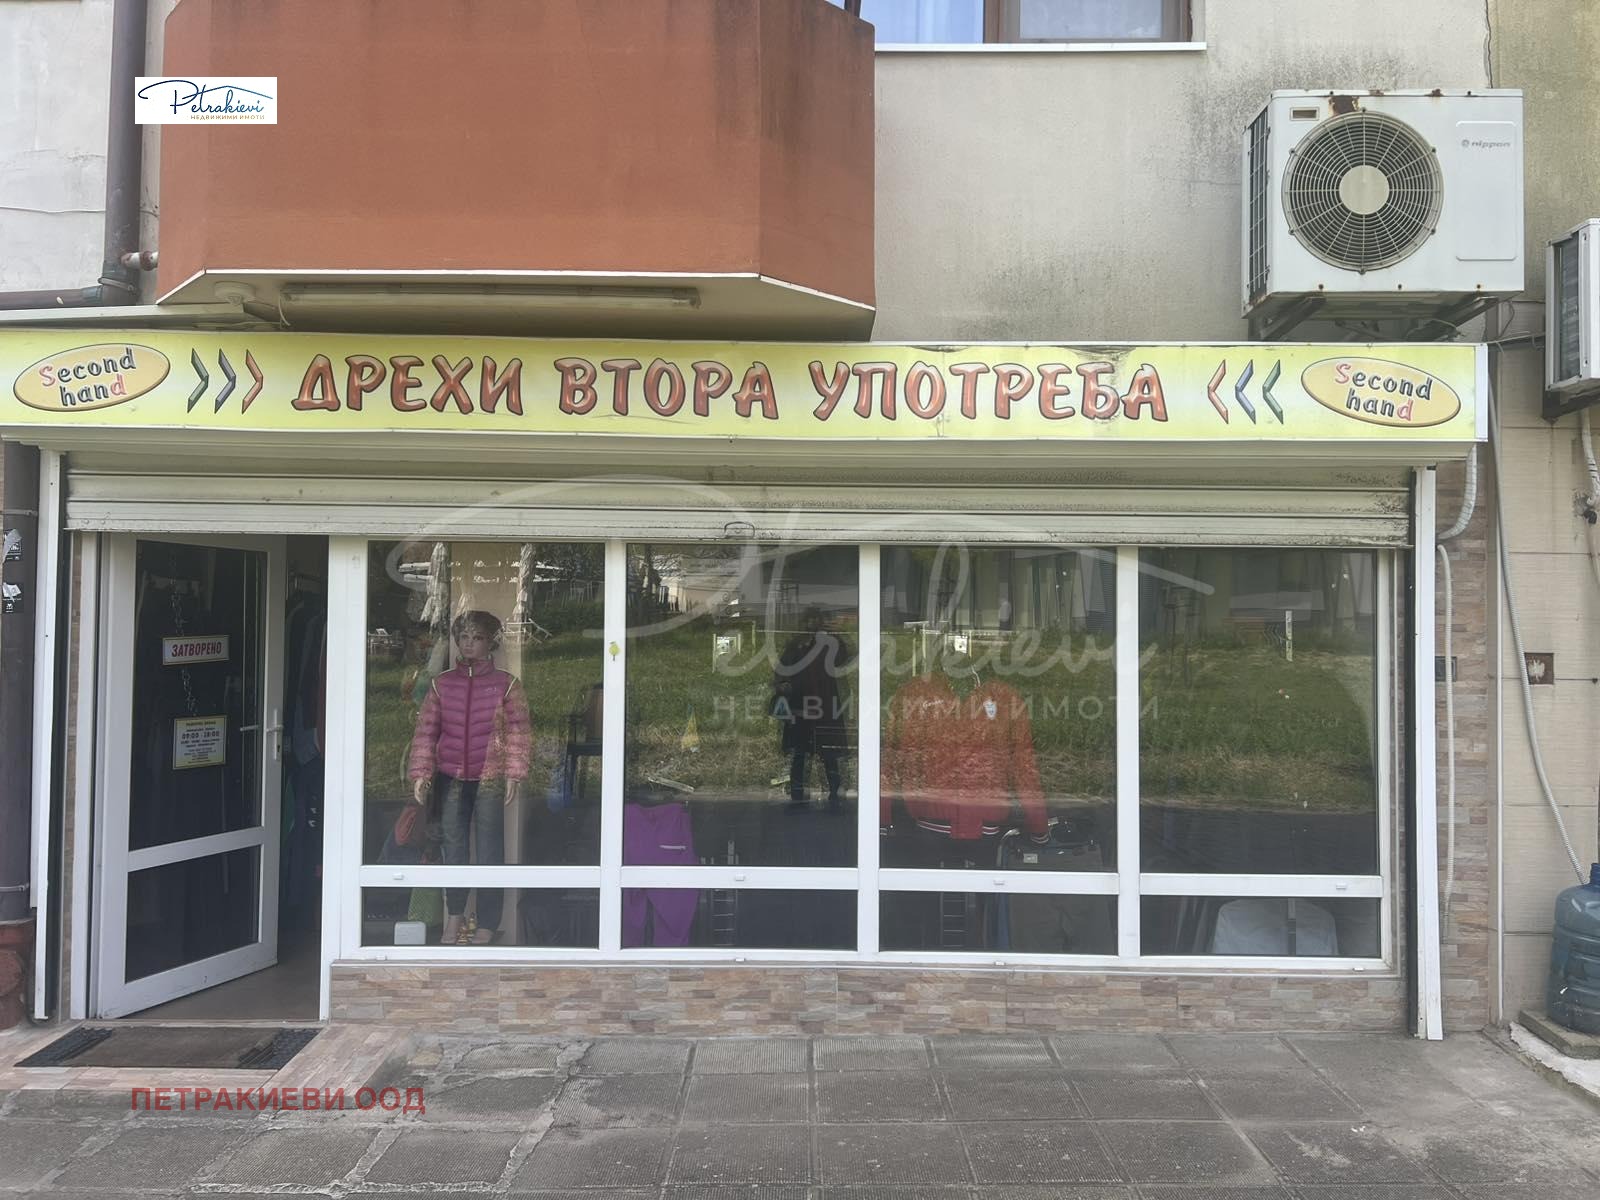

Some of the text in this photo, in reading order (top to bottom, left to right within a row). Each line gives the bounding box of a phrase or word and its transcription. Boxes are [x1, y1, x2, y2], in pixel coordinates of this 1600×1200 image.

[38, 347, 137, 387] Second
[1334, 362, 1434, 400] Second
[59, 374, 128, 407] hand
[291, 353, 1169, 422] ДРЕХИ ВТОРА УПОТРЕБА
[1345, 387, 1414, 421] hand
[171, 641, 222, 657] ЗАТВОРЕНО
